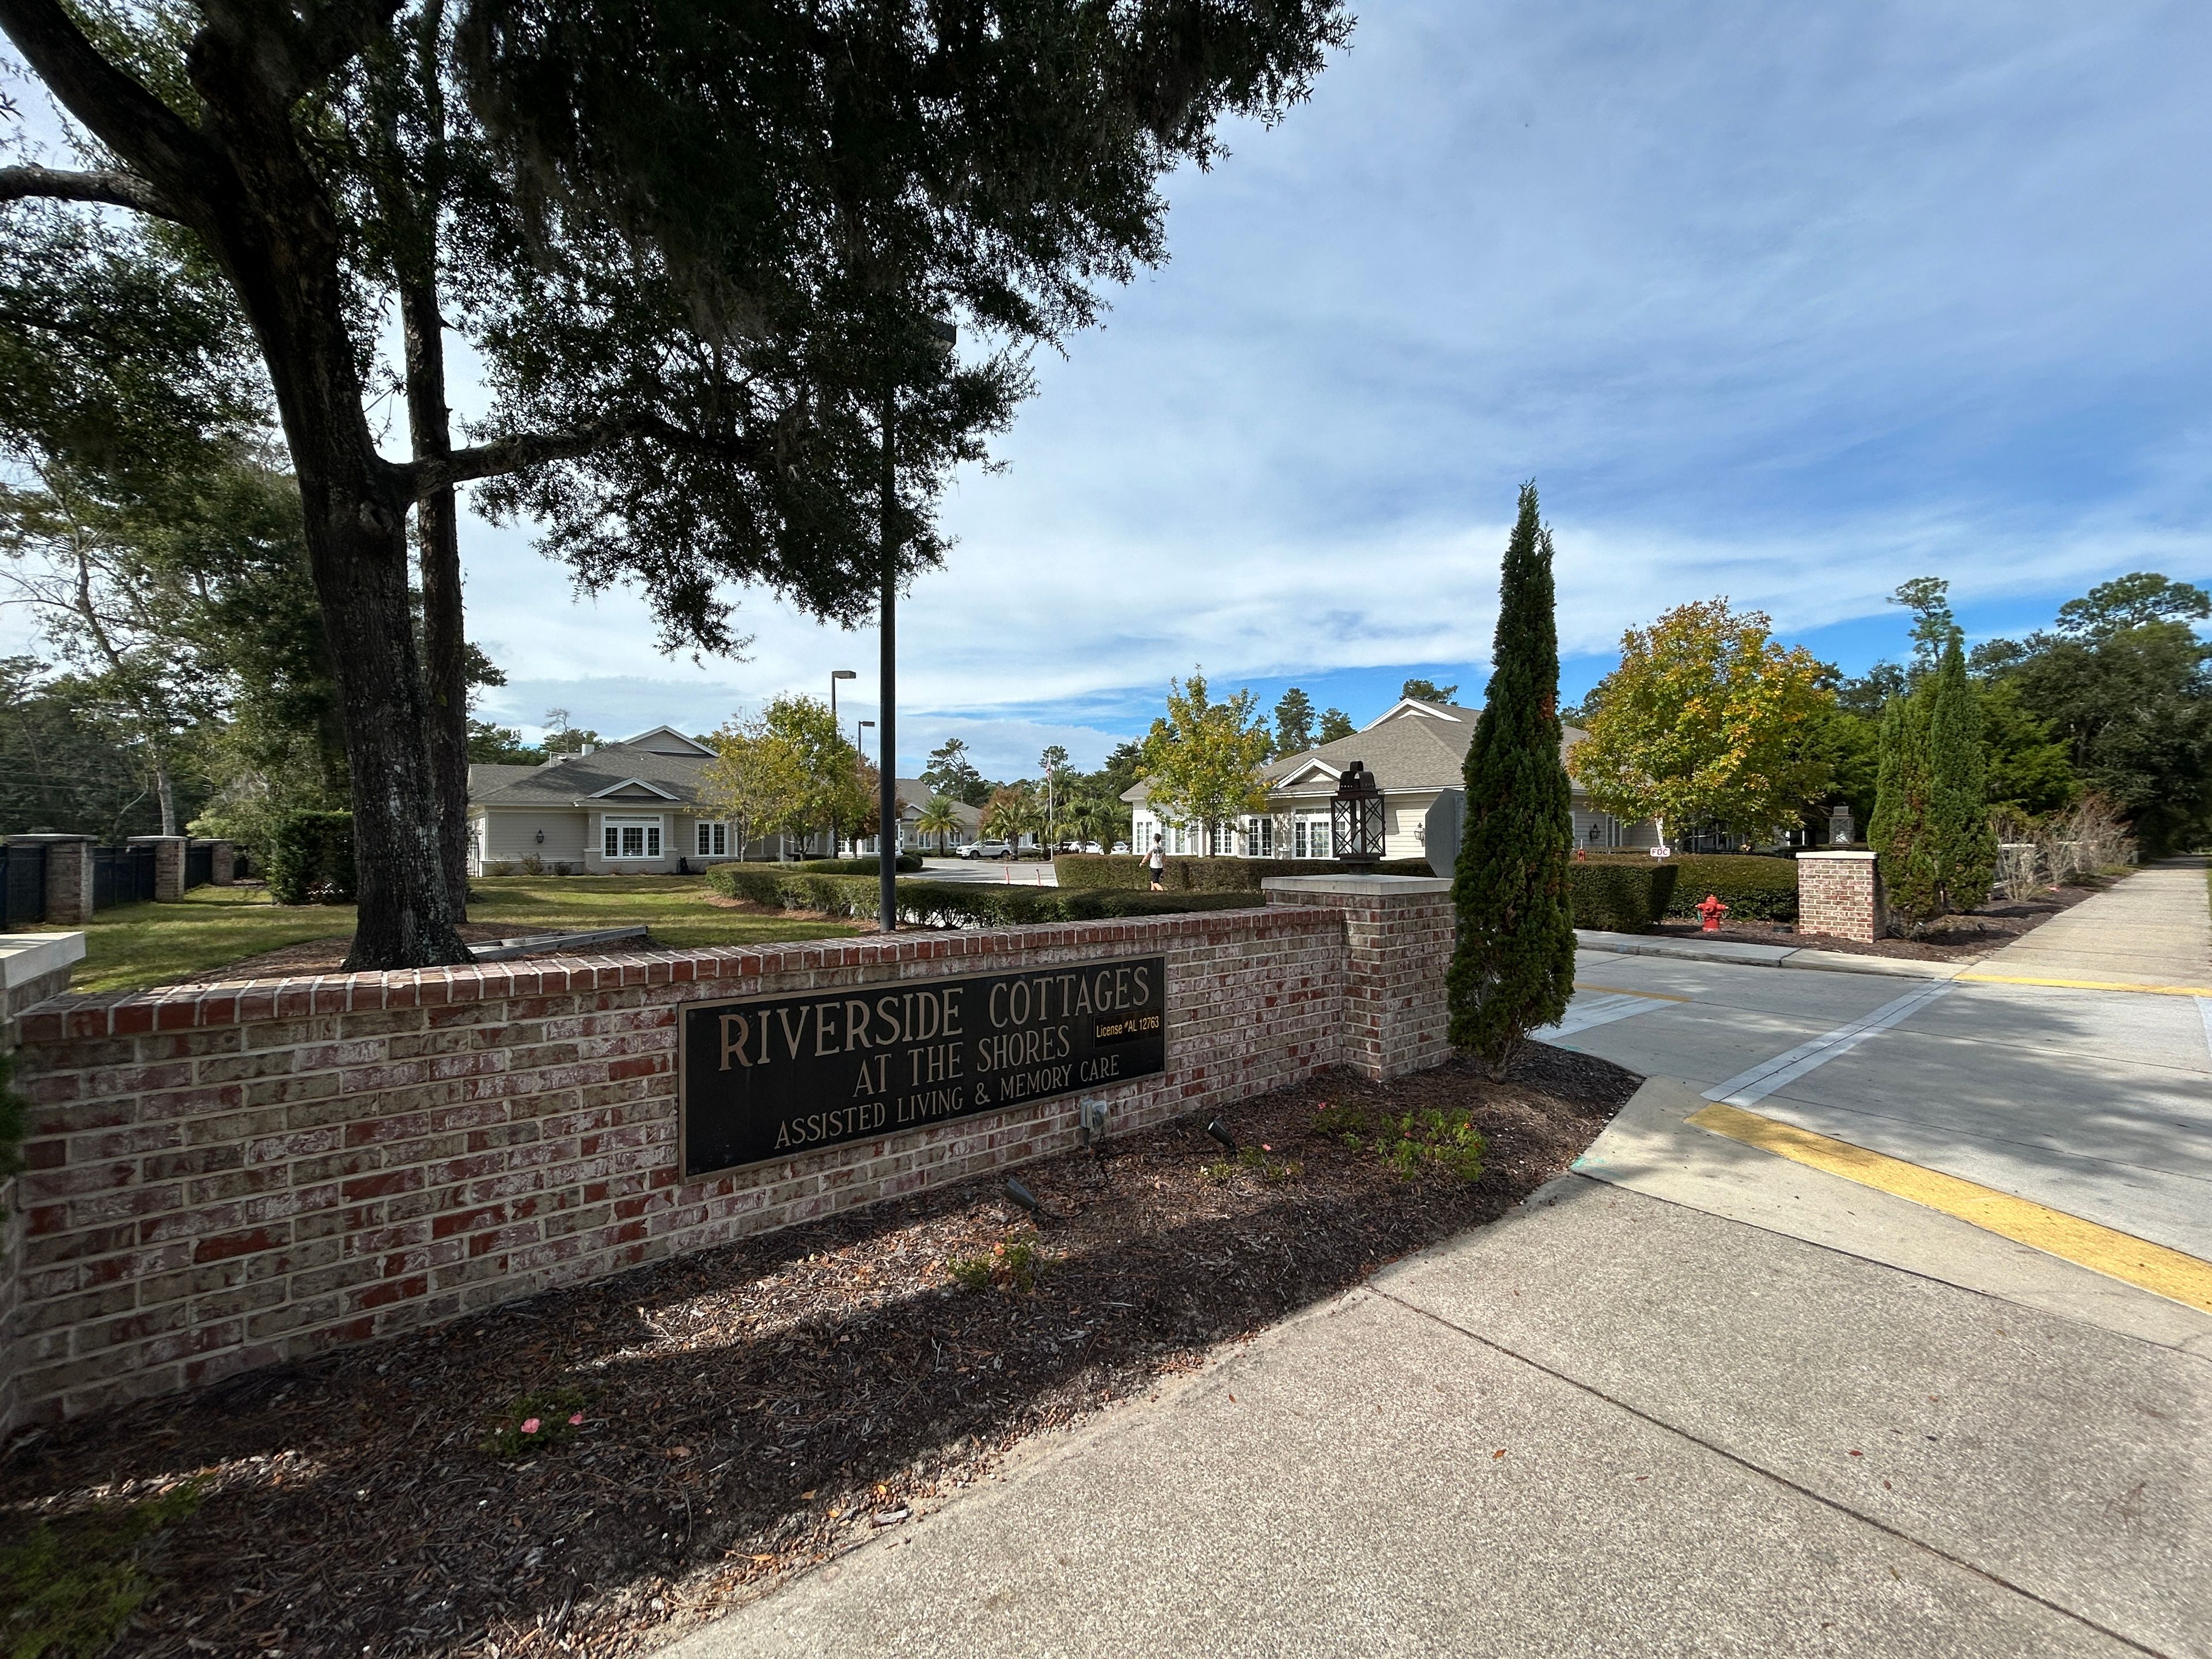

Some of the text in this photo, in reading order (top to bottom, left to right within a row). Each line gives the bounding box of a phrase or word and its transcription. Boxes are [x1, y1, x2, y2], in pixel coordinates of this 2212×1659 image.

[718, 965, 1149, 1071] RIVERSIDE COTTAGES
[1096, 1016, 1159, 1037] License #AL 12763
[774, 1054, 1120, 1150] ASSISTED LIVING & MEMORY CARE
[852, 1025, 1070, 1097] AT THE SHORES
